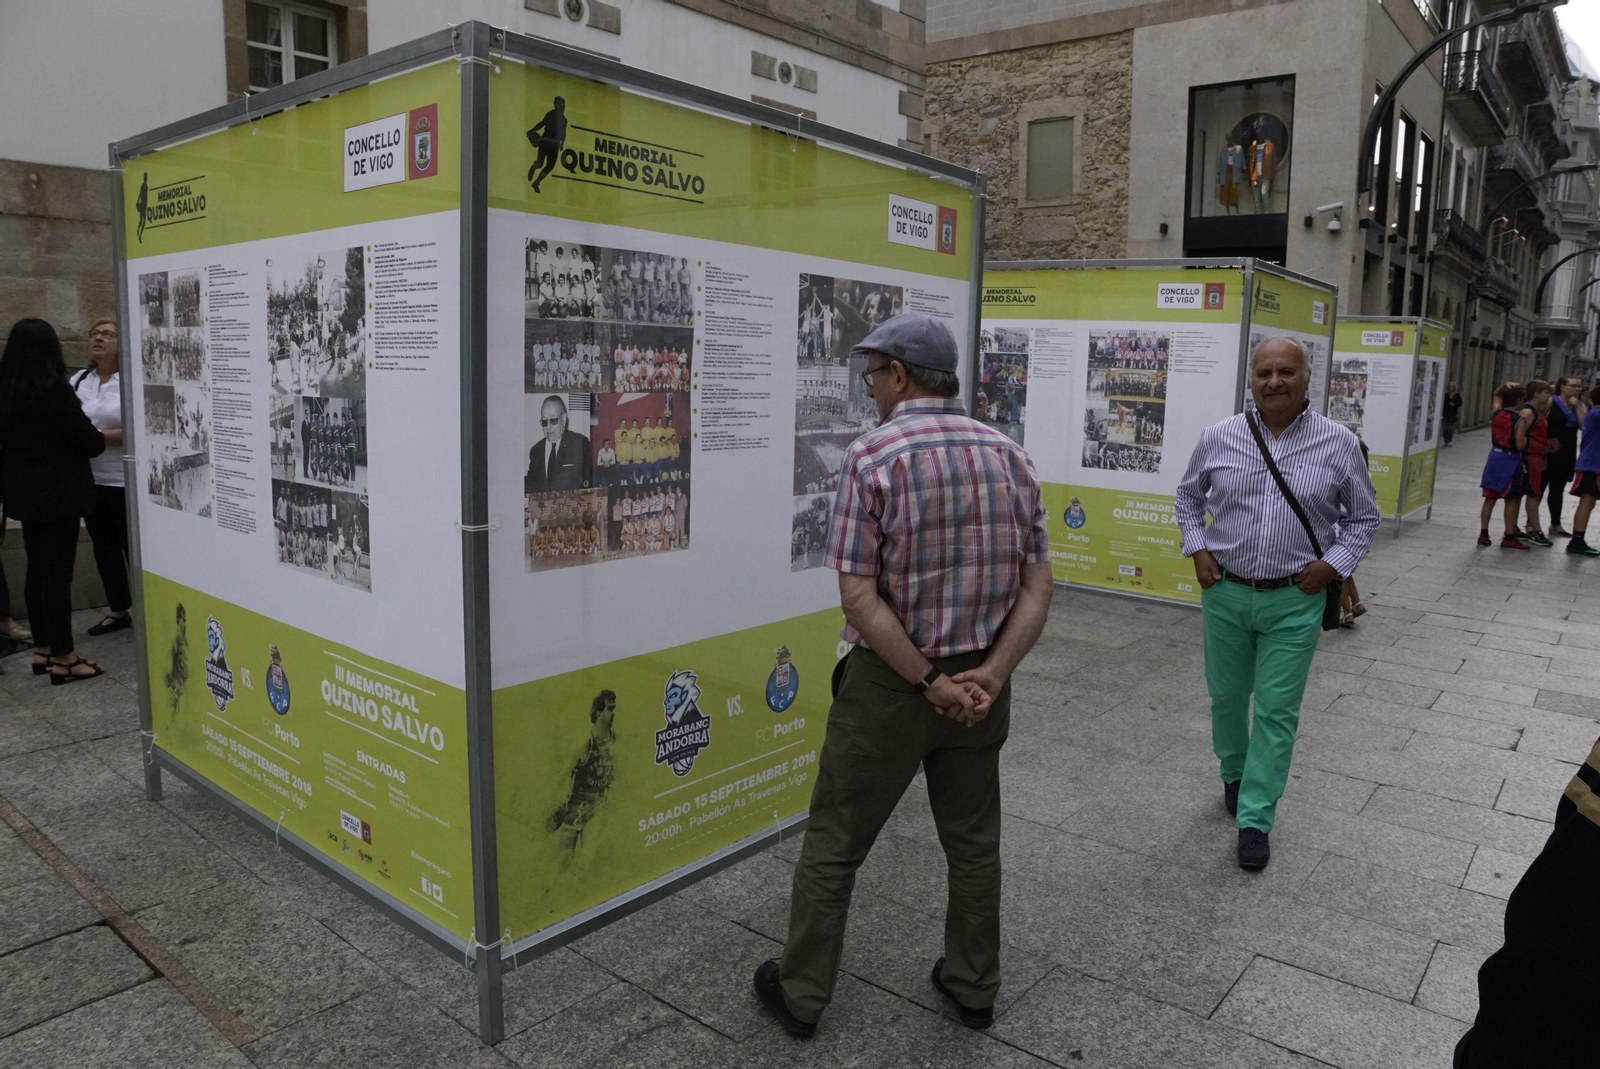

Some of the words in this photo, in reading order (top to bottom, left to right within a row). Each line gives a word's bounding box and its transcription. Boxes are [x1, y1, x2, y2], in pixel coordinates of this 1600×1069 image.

[348, 128, 401, 157] CONCELLO
[594, 137, 677, 168] MEMORIAL
[354, 158, 366, 176] DE
[369, 152, 394, 173] VIGO
[560, 148, 639, 182] QUINO
[641, 164, 705, 195] SALVO
[157, 184, 192, 202] MEMORIAL
[146, 201, 175, 224] QUINO
[176, 194, 206, 216] SALVO
[891, 204, 933, 225] CONCELLO
[896, 220, 907, 235] DE
[909, 223, 928, 239] VIGO
[982, 295, 1005, 303] UINO
[1006, 295, 1036, 303] SALVO
[1160, 288, 1200, 296] CONCELLO
[1164, 296, 1174, 304] DE
[1176, 296, 1195, 304] VIGO
[1112, 507, 1159, 523] QUINO
[1126, 500, 1134, 508] III
[1135, 501, 1177, 514] MEMORI
[1067, 533, 1090, 543] Porto
[1137, 535, 1175, 546] ENTRADAS
[1076, 562, 1091, 571] Vigo
[1079, 555, 1097, 564] 2018
[335, 664, 344, 682] III
[346, 670, 420, 714] MEMORIAL
[321, 679, 379, 723] QUINO
[381, 705, 445, 751] SALVO
[274, 723, 300, 749] Porto
[657, 718, 709, 743] MORABANC
[755, 727, 771, 745] FC
[772, 717, 806, 739] Porto
[657, 730, 708, 760] ANDORRA
[228, 738, 238, 752] 15
[237, 743, 290, 784] SEPTIEMBRE
[291, 774, 313, 797] 2018
[356, 749, 406, 784] ENTRADAS
[253, 768, 262, 782] As
[262, 773, 290, 799] Travesas
[290, 790, 308, 810] Vigo
[638, 801, 691, 832] SÁBADO
[694, 795, 708, 810] 15
[709, 761, 789, 804] SEPTIEMBRE
[792, 750, 816, 770] 2018
[644, 822, 682, 848] 20:00h
[689, 802, 731, 828] Pabellón
[733, 798, 746, 813] As
[747, 781, 786, 803] Travesas
[788, 772, 808, 787] Vigo
